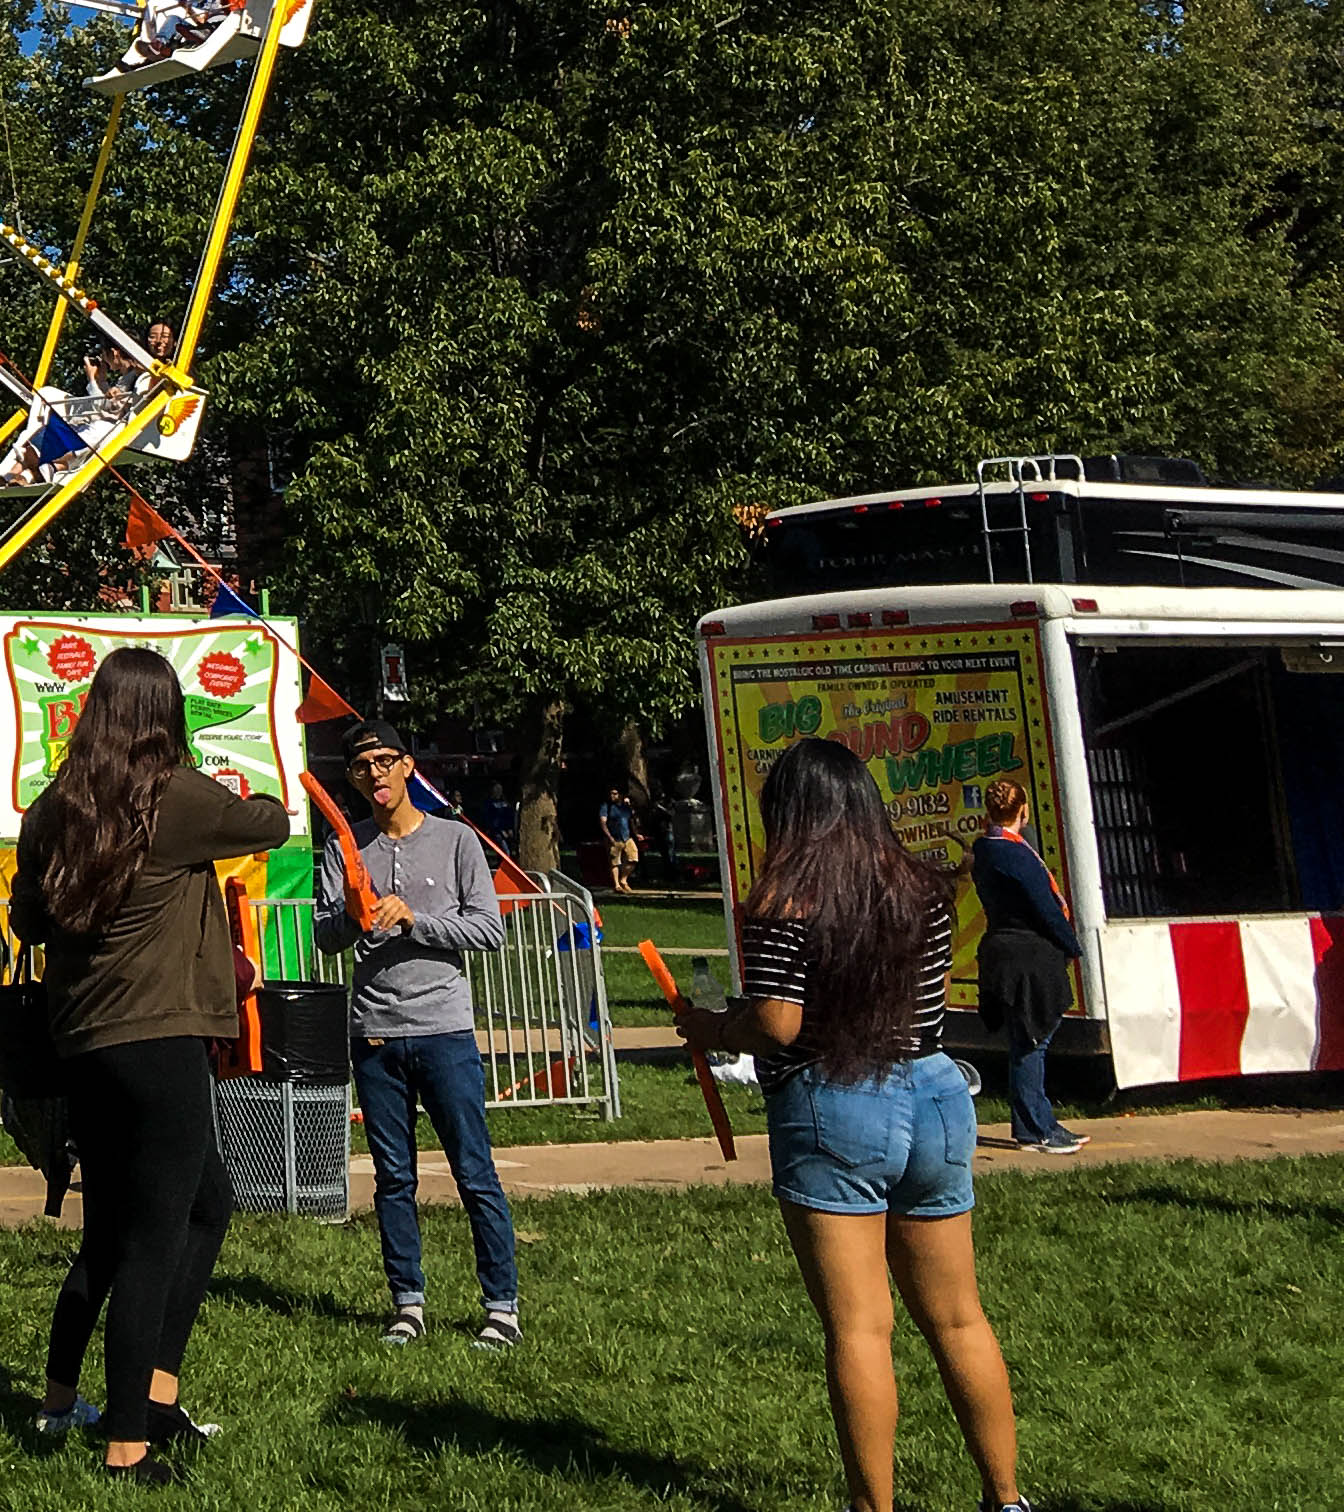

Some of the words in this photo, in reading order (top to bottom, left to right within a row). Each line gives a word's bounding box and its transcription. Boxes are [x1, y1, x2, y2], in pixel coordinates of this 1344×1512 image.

[733, 670, 755, 680] BRING
[757, 669, 772, 679] THE
[774, 667, 813, 678] NOSTALGIC
[815, 665, 831, 676] OLD
[833, 664, 852, 675] TIME
[854, 662, 891, 674] CARNIVAL
[893, 661, 925, 672] FEELING
[927, 660, 939, 670] TO
[942, 659, 963, 670] YOUR
[965, 658, 987, 668] NEXT
[989, 657, 1016, 667] EVENT
[848, 681, 879, 690] OWNED
[890, 678, 935, 689] OPERATED
[935, 690, 1008, 705] AMUSEMENT
[759, 695, 822, 744] BIG
[933, 708, 959, 723] RIDE
[963, 707, 1017, 722] RENTALS
[886, 731, 1023, 794] WHEEL
[885, 792, 949, 822] 9-9132
